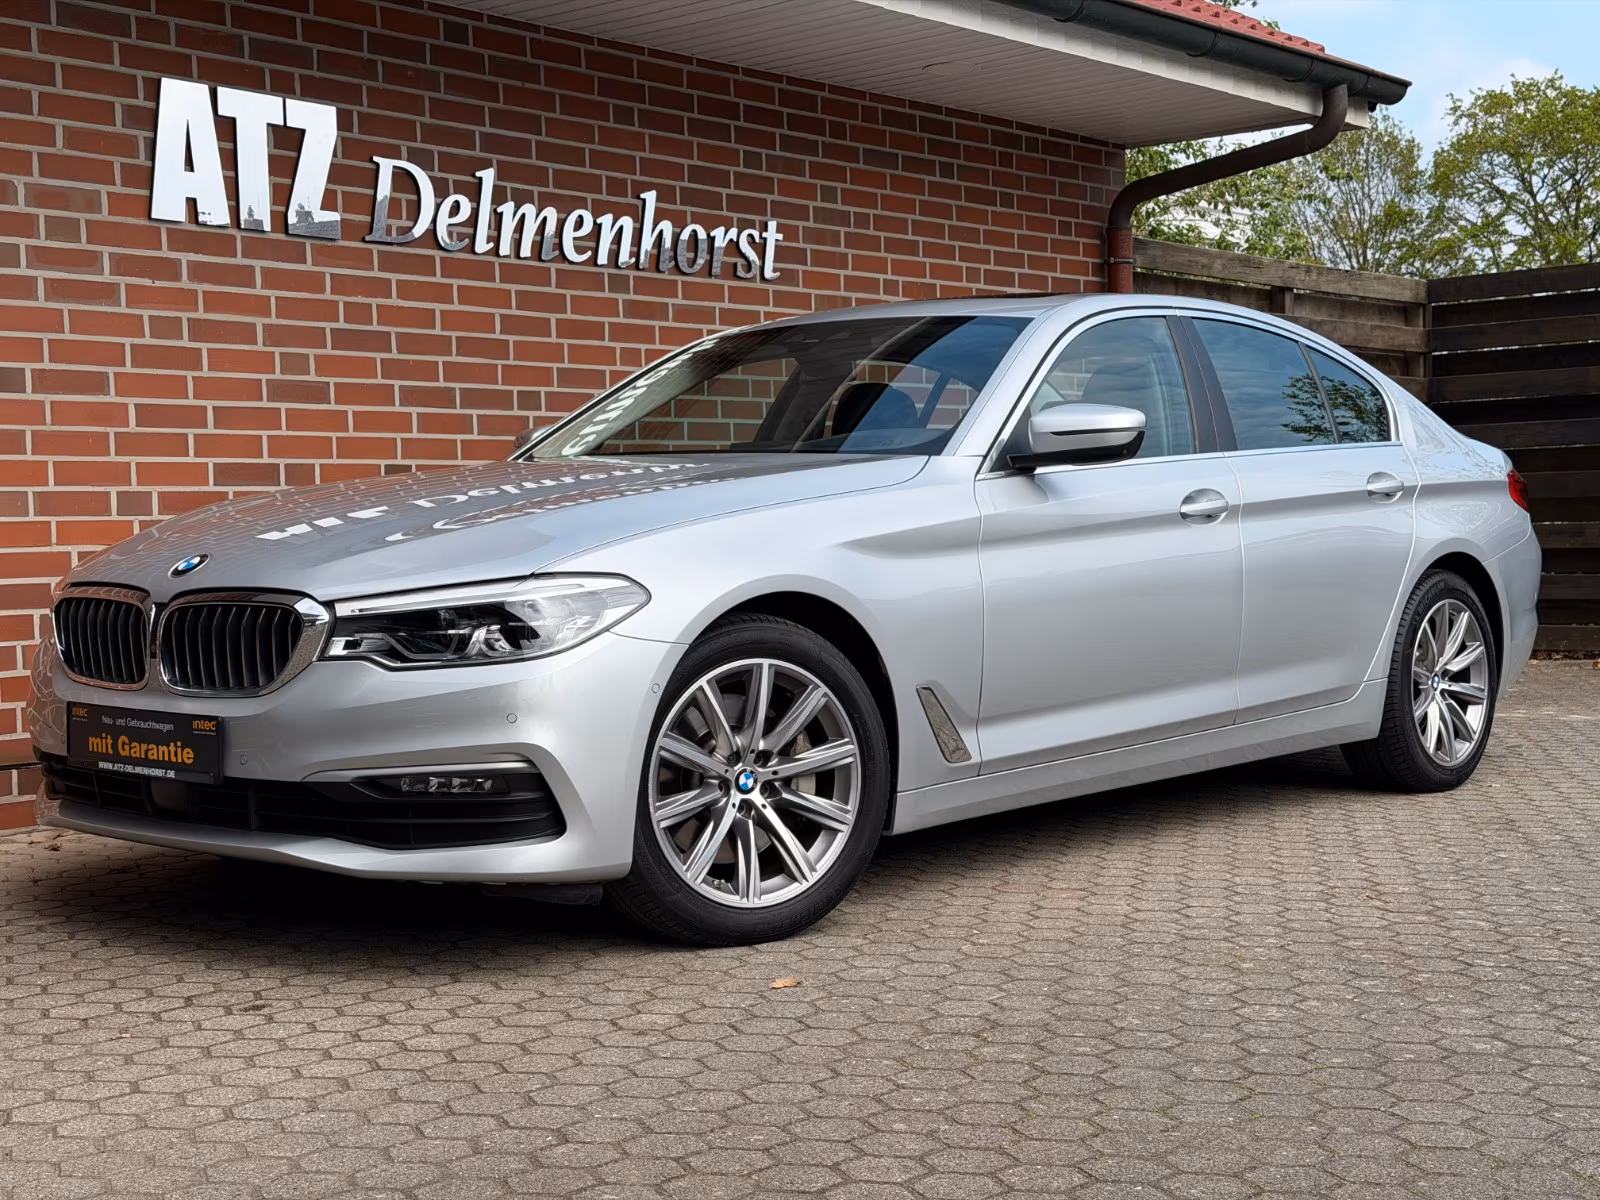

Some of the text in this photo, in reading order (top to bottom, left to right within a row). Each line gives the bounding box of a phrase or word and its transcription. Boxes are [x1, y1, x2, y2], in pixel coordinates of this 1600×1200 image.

[149, 76, 785, 281] ATZ Delmenhorst
[115, 717, 126, 726] und
[126, 718, 174, 733] Gebrauchtwagen
[192, 719, 217, 731] intec
[88, 733, 195, 765] mit Garantie
